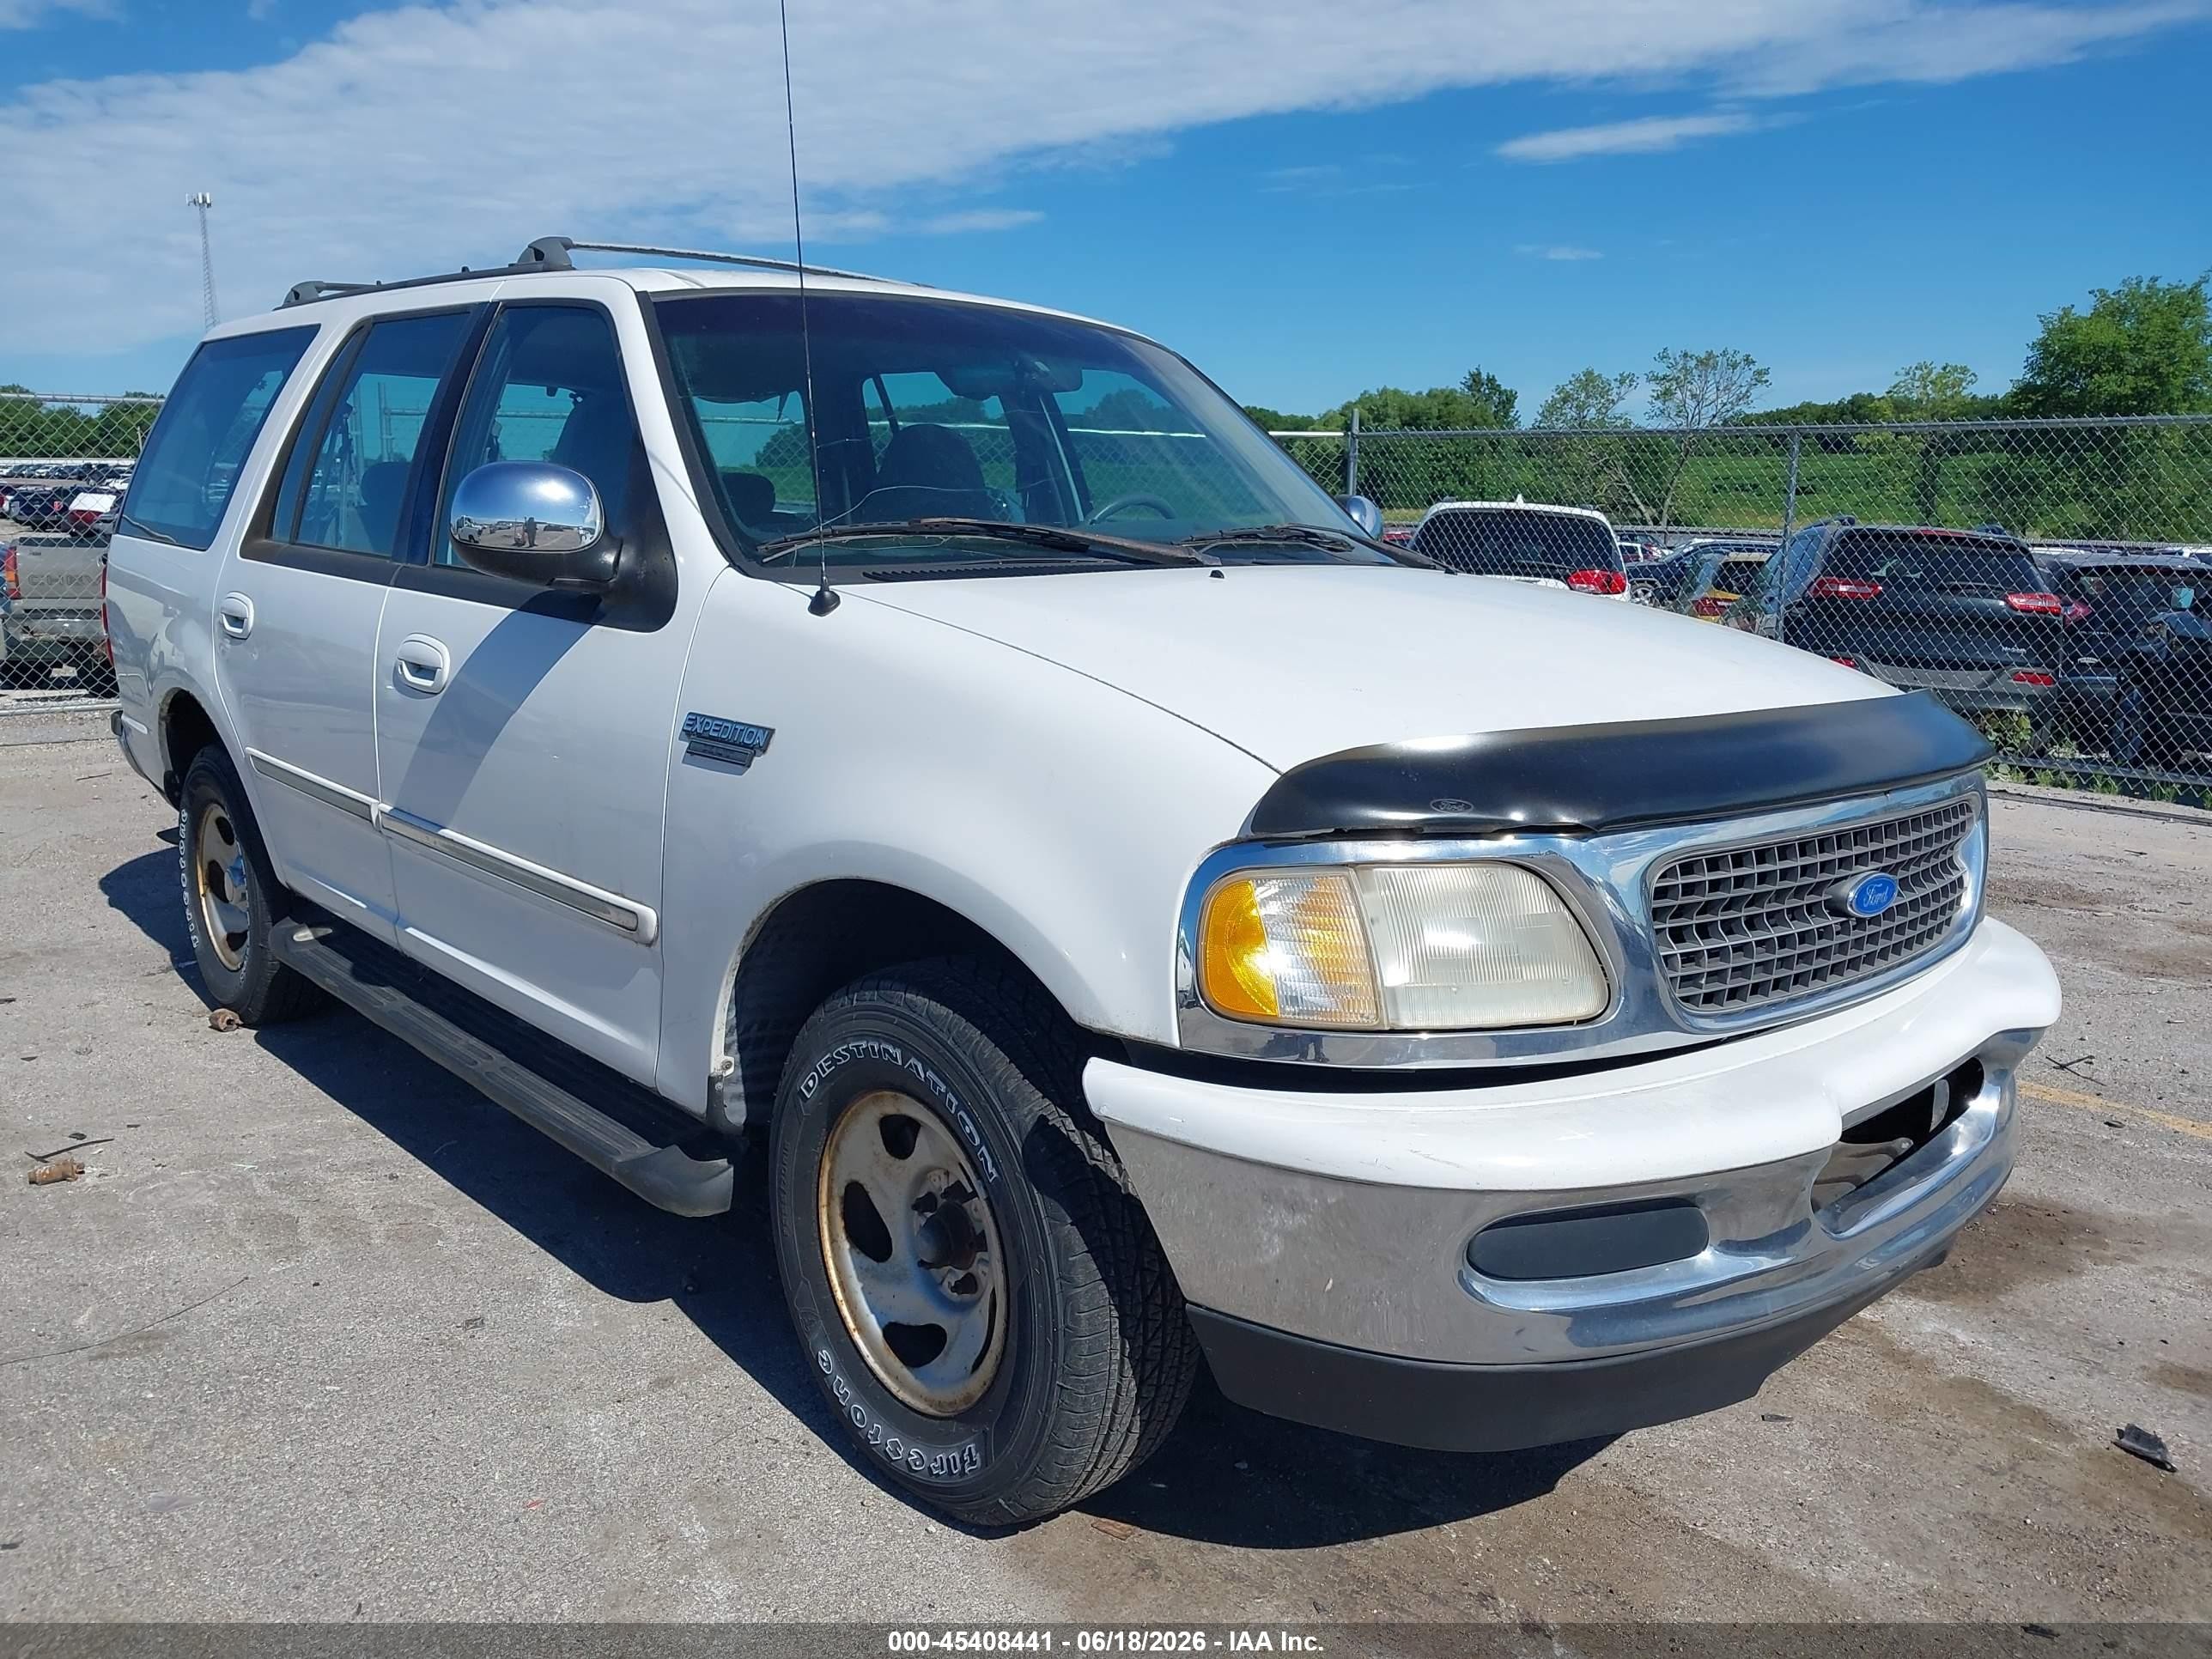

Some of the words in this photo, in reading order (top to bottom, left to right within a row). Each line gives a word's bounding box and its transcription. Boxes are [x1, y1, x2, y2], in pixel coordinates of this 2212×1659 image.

[683, 714, 769, 747] EXPEDITION
[1863, 884, 1889, 908] Ford
[799, 1040, 999, 1184] DESTINATION
